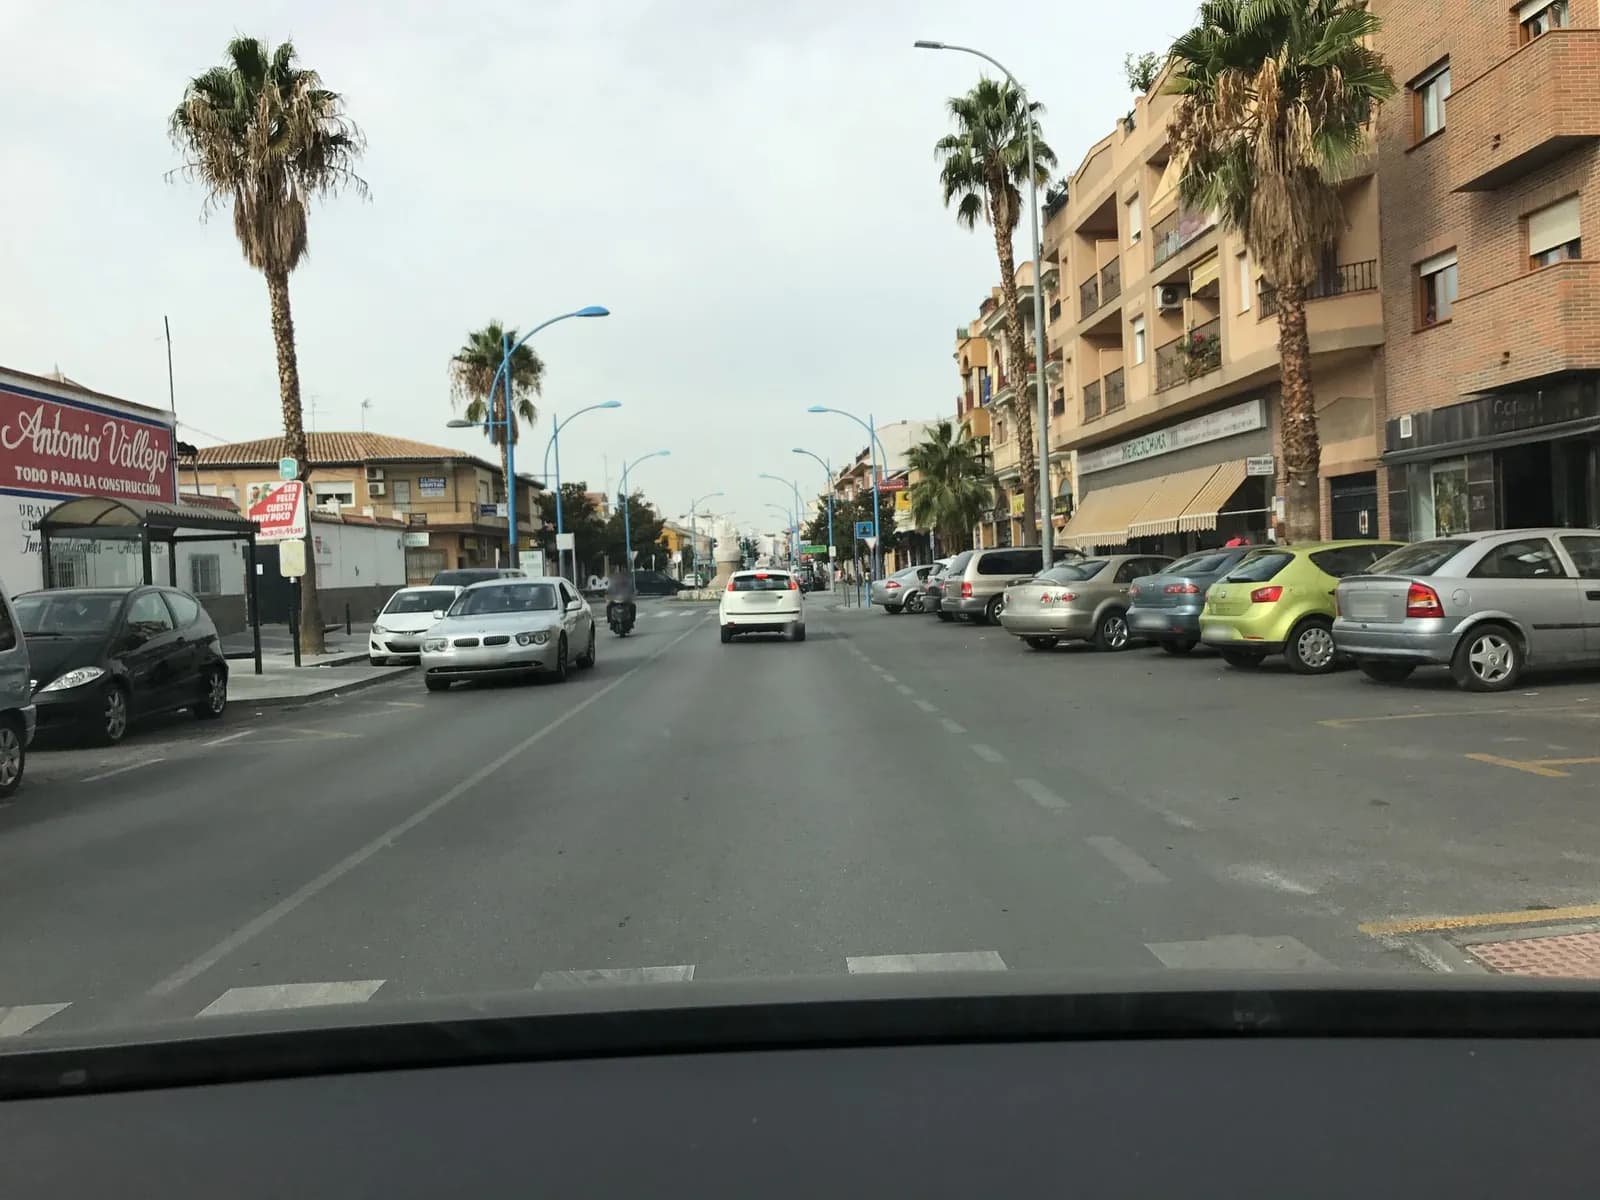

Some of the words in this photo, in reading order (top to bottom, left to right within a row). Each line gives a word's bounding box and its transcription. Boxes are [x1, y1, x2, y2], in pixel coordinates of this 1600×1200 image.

[1, 404, 101, 462] Antonio
[103, 420, 169, 483] Vallejo
[15, 465, 48, 483] TODO
[51, 469, 82, 488] PARA
[83, 474, 97, 490] LA
[98, 476, 161, 497] CONSTRUCCION
[283, 483, 298, 493] SER
[276, 493, 296, 503] FELIZ
[266, 502, 293, 513] CUESTA
[270, 511, 291, 521] POCO
